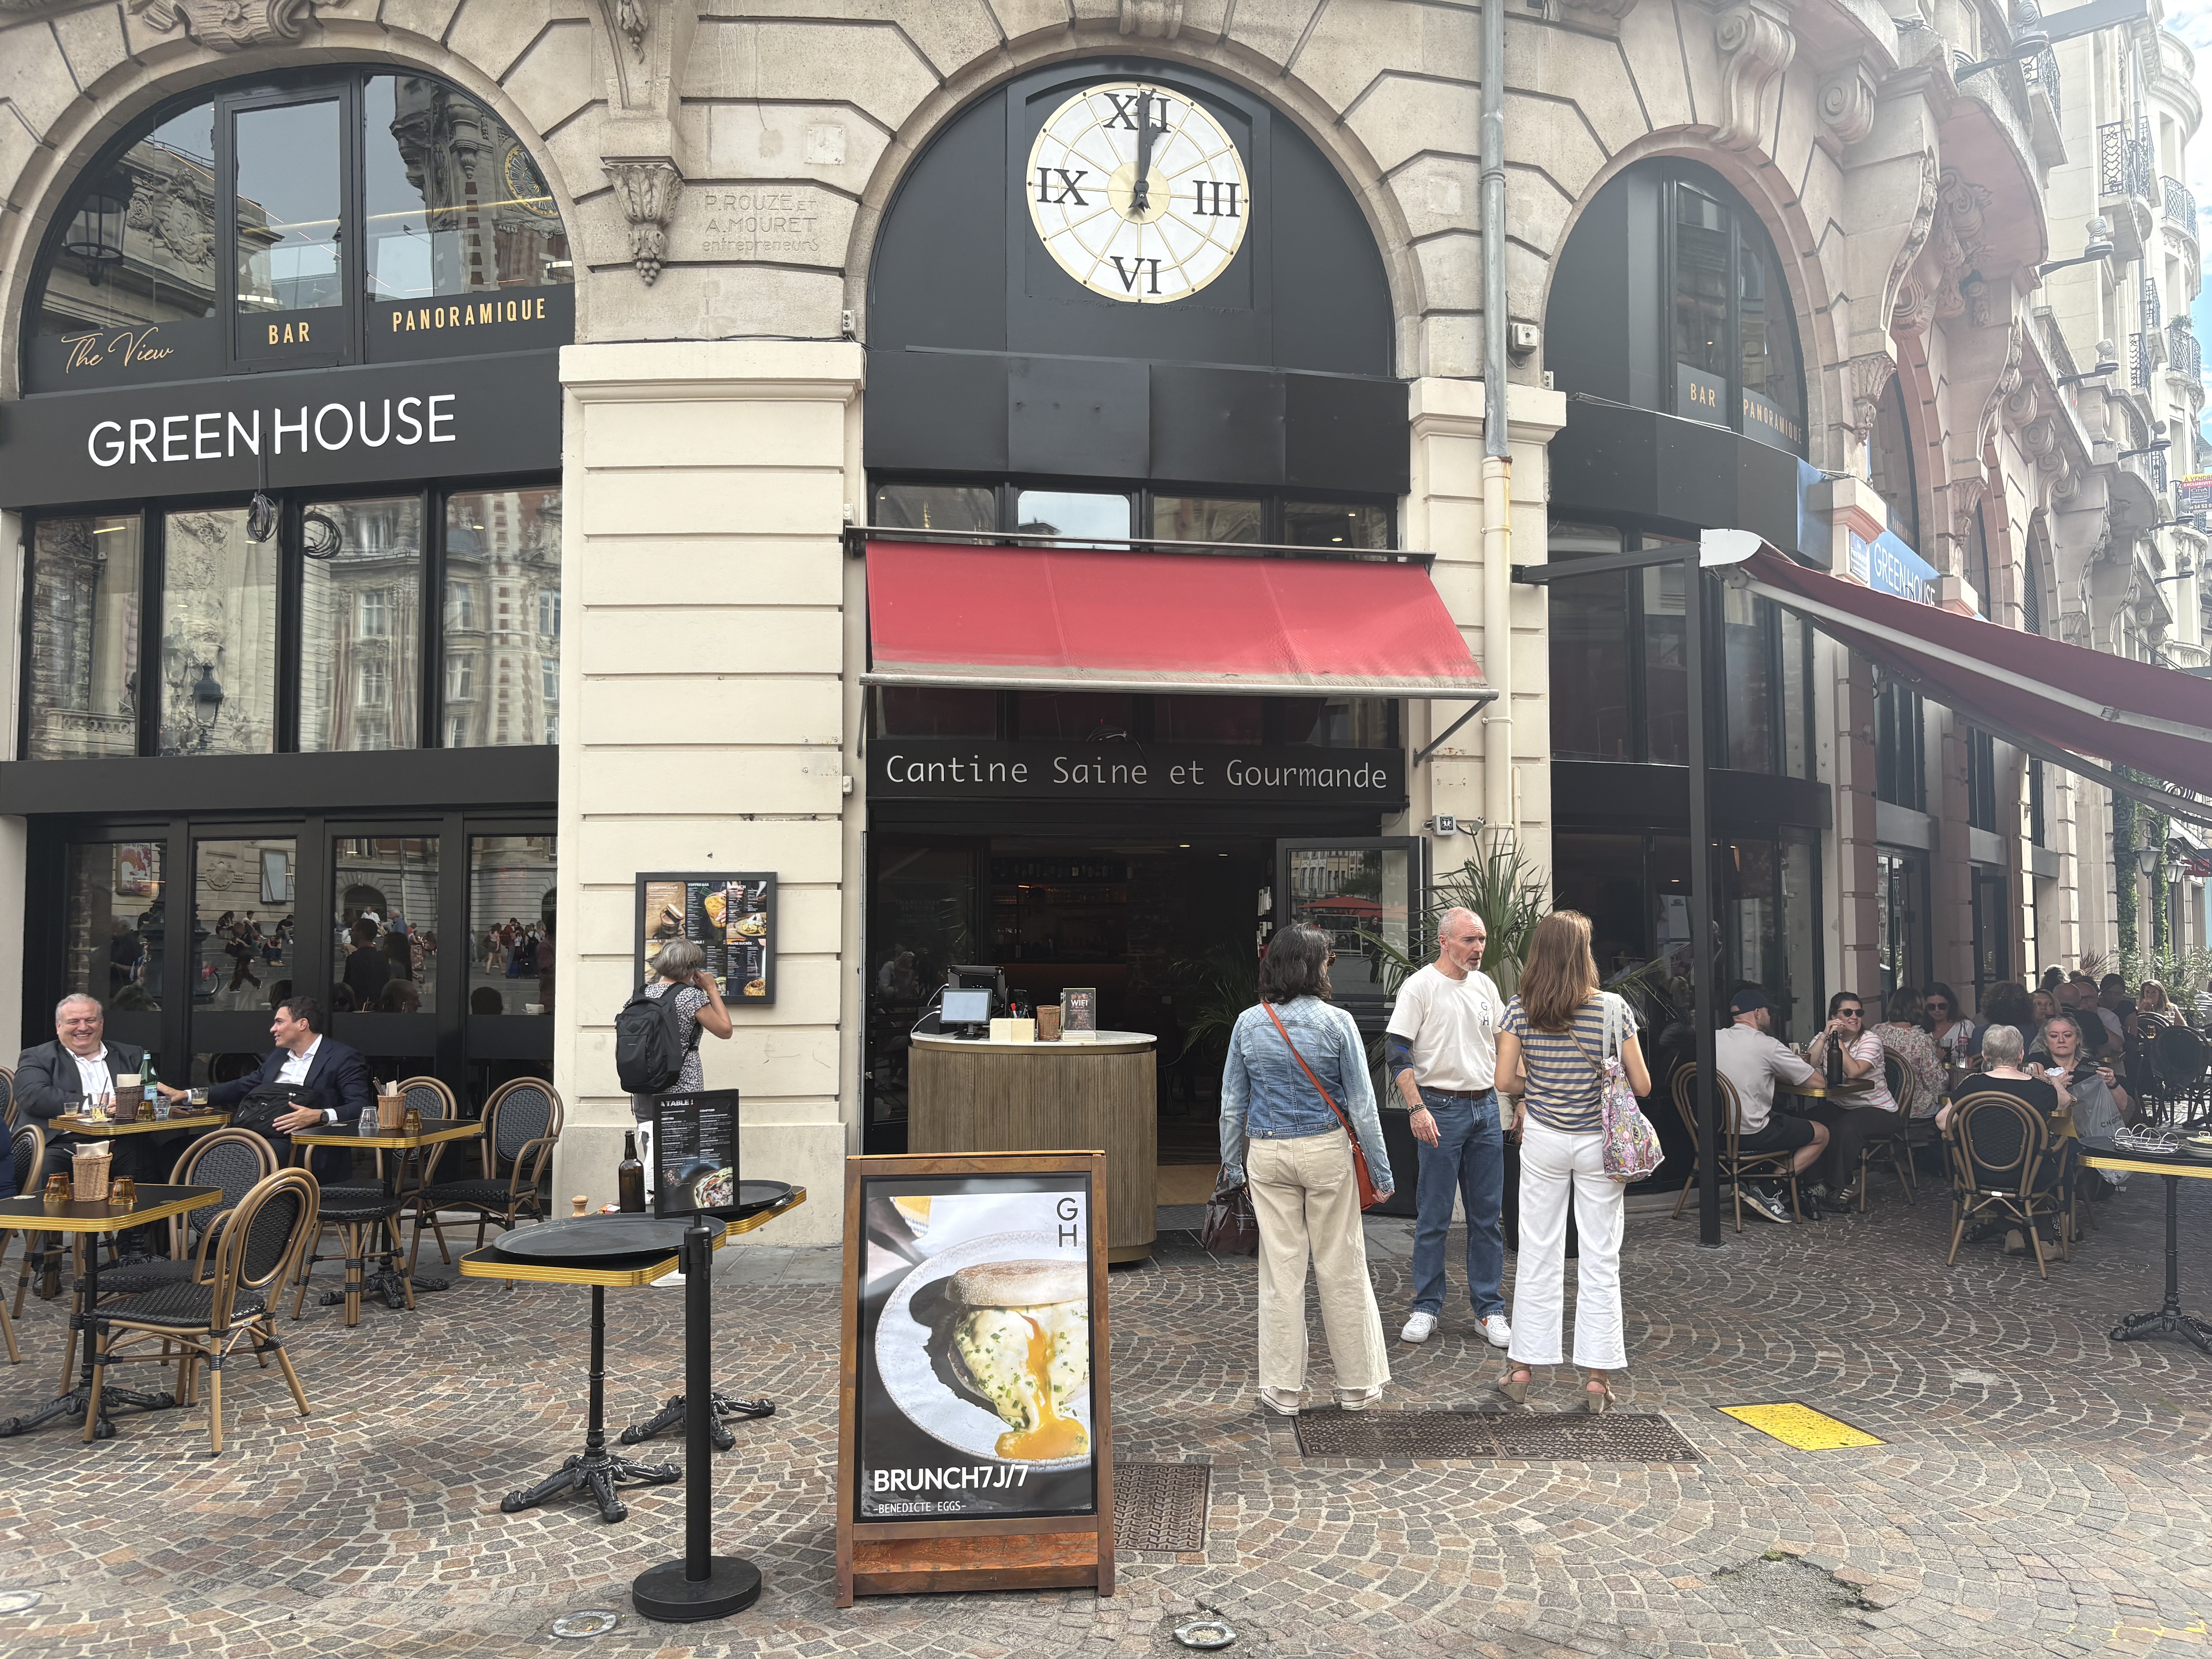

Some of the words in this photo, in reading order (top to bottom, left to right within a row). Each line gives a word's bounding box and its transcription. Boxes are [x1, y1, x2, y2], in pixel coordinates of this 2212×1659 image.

[1036, 167, 1089, 206] IX
[1192, 180, 1240, 217] III
[702, 237, 819, 256] entrepreneurs
[1110, 256, 1161, 294] VI
[392, 297, 546, 332] PANORAMIQUE
[61, 332, 103, 373] The
[108, 327, 174, 367] View
[269, 322, 310, 345] BAR
[1690, 382, 1716, 408] BAR
[1743, 398, 1802, 445] PANORAMIQUE
[887, 755, 1028, 783] Cantine
[1053, 756, 1147, 785] Saine
[1170, 761, 1204, 785] et
[1226, 759, 1387, 789] Gourmande
